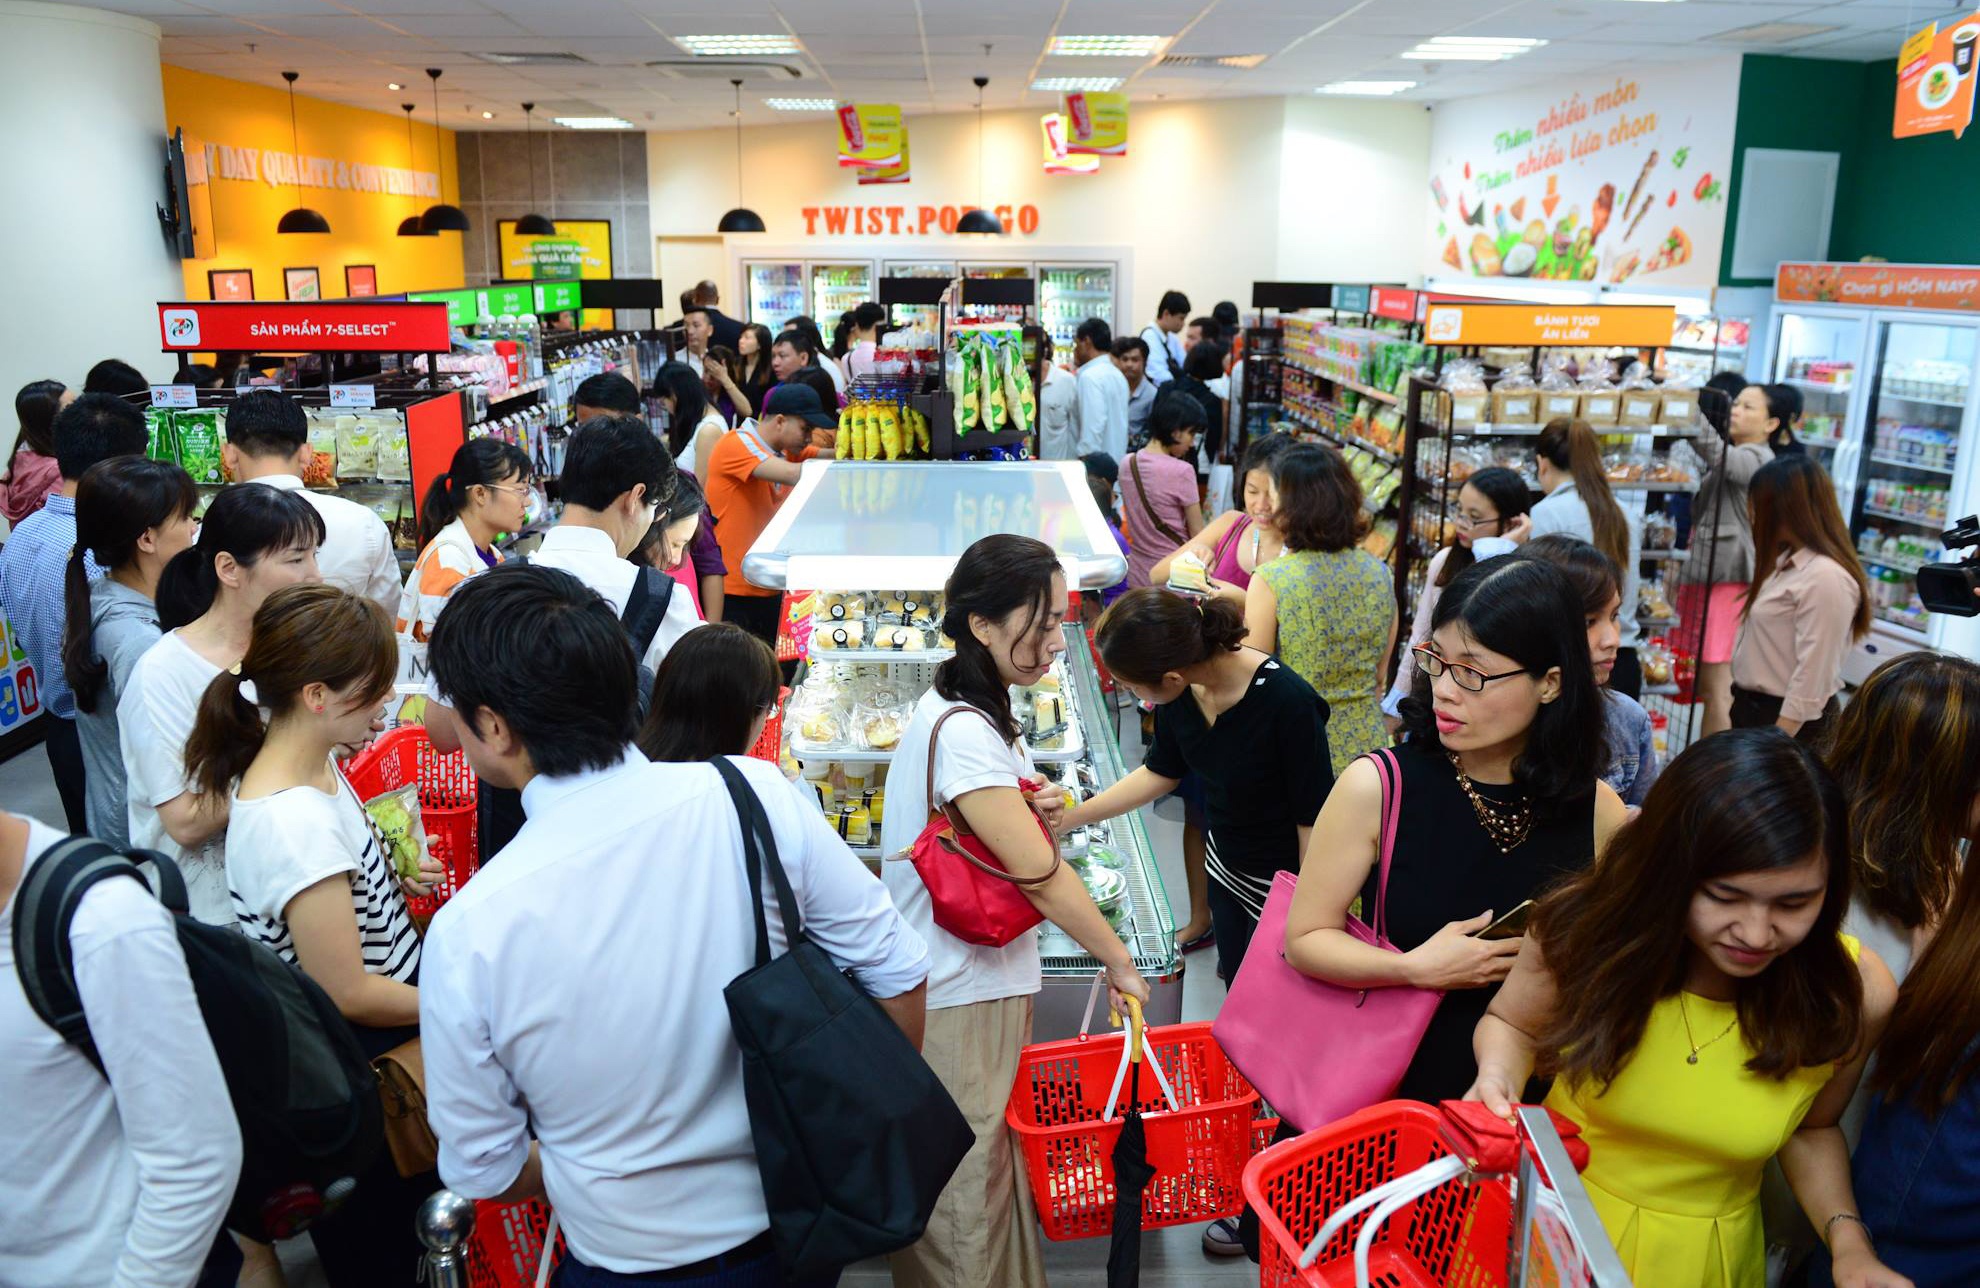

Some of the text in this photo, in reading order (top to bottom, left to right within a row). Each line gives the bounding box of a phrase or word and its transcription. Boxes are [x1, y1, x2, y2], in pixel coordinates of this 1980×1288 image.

[262, 150, 335, 189] QUALITY
[1935, 279, 1977, 294] NAY?
[250, 321, 279, 336] SẢN
[282, 319, 322, 336] PHẨM
